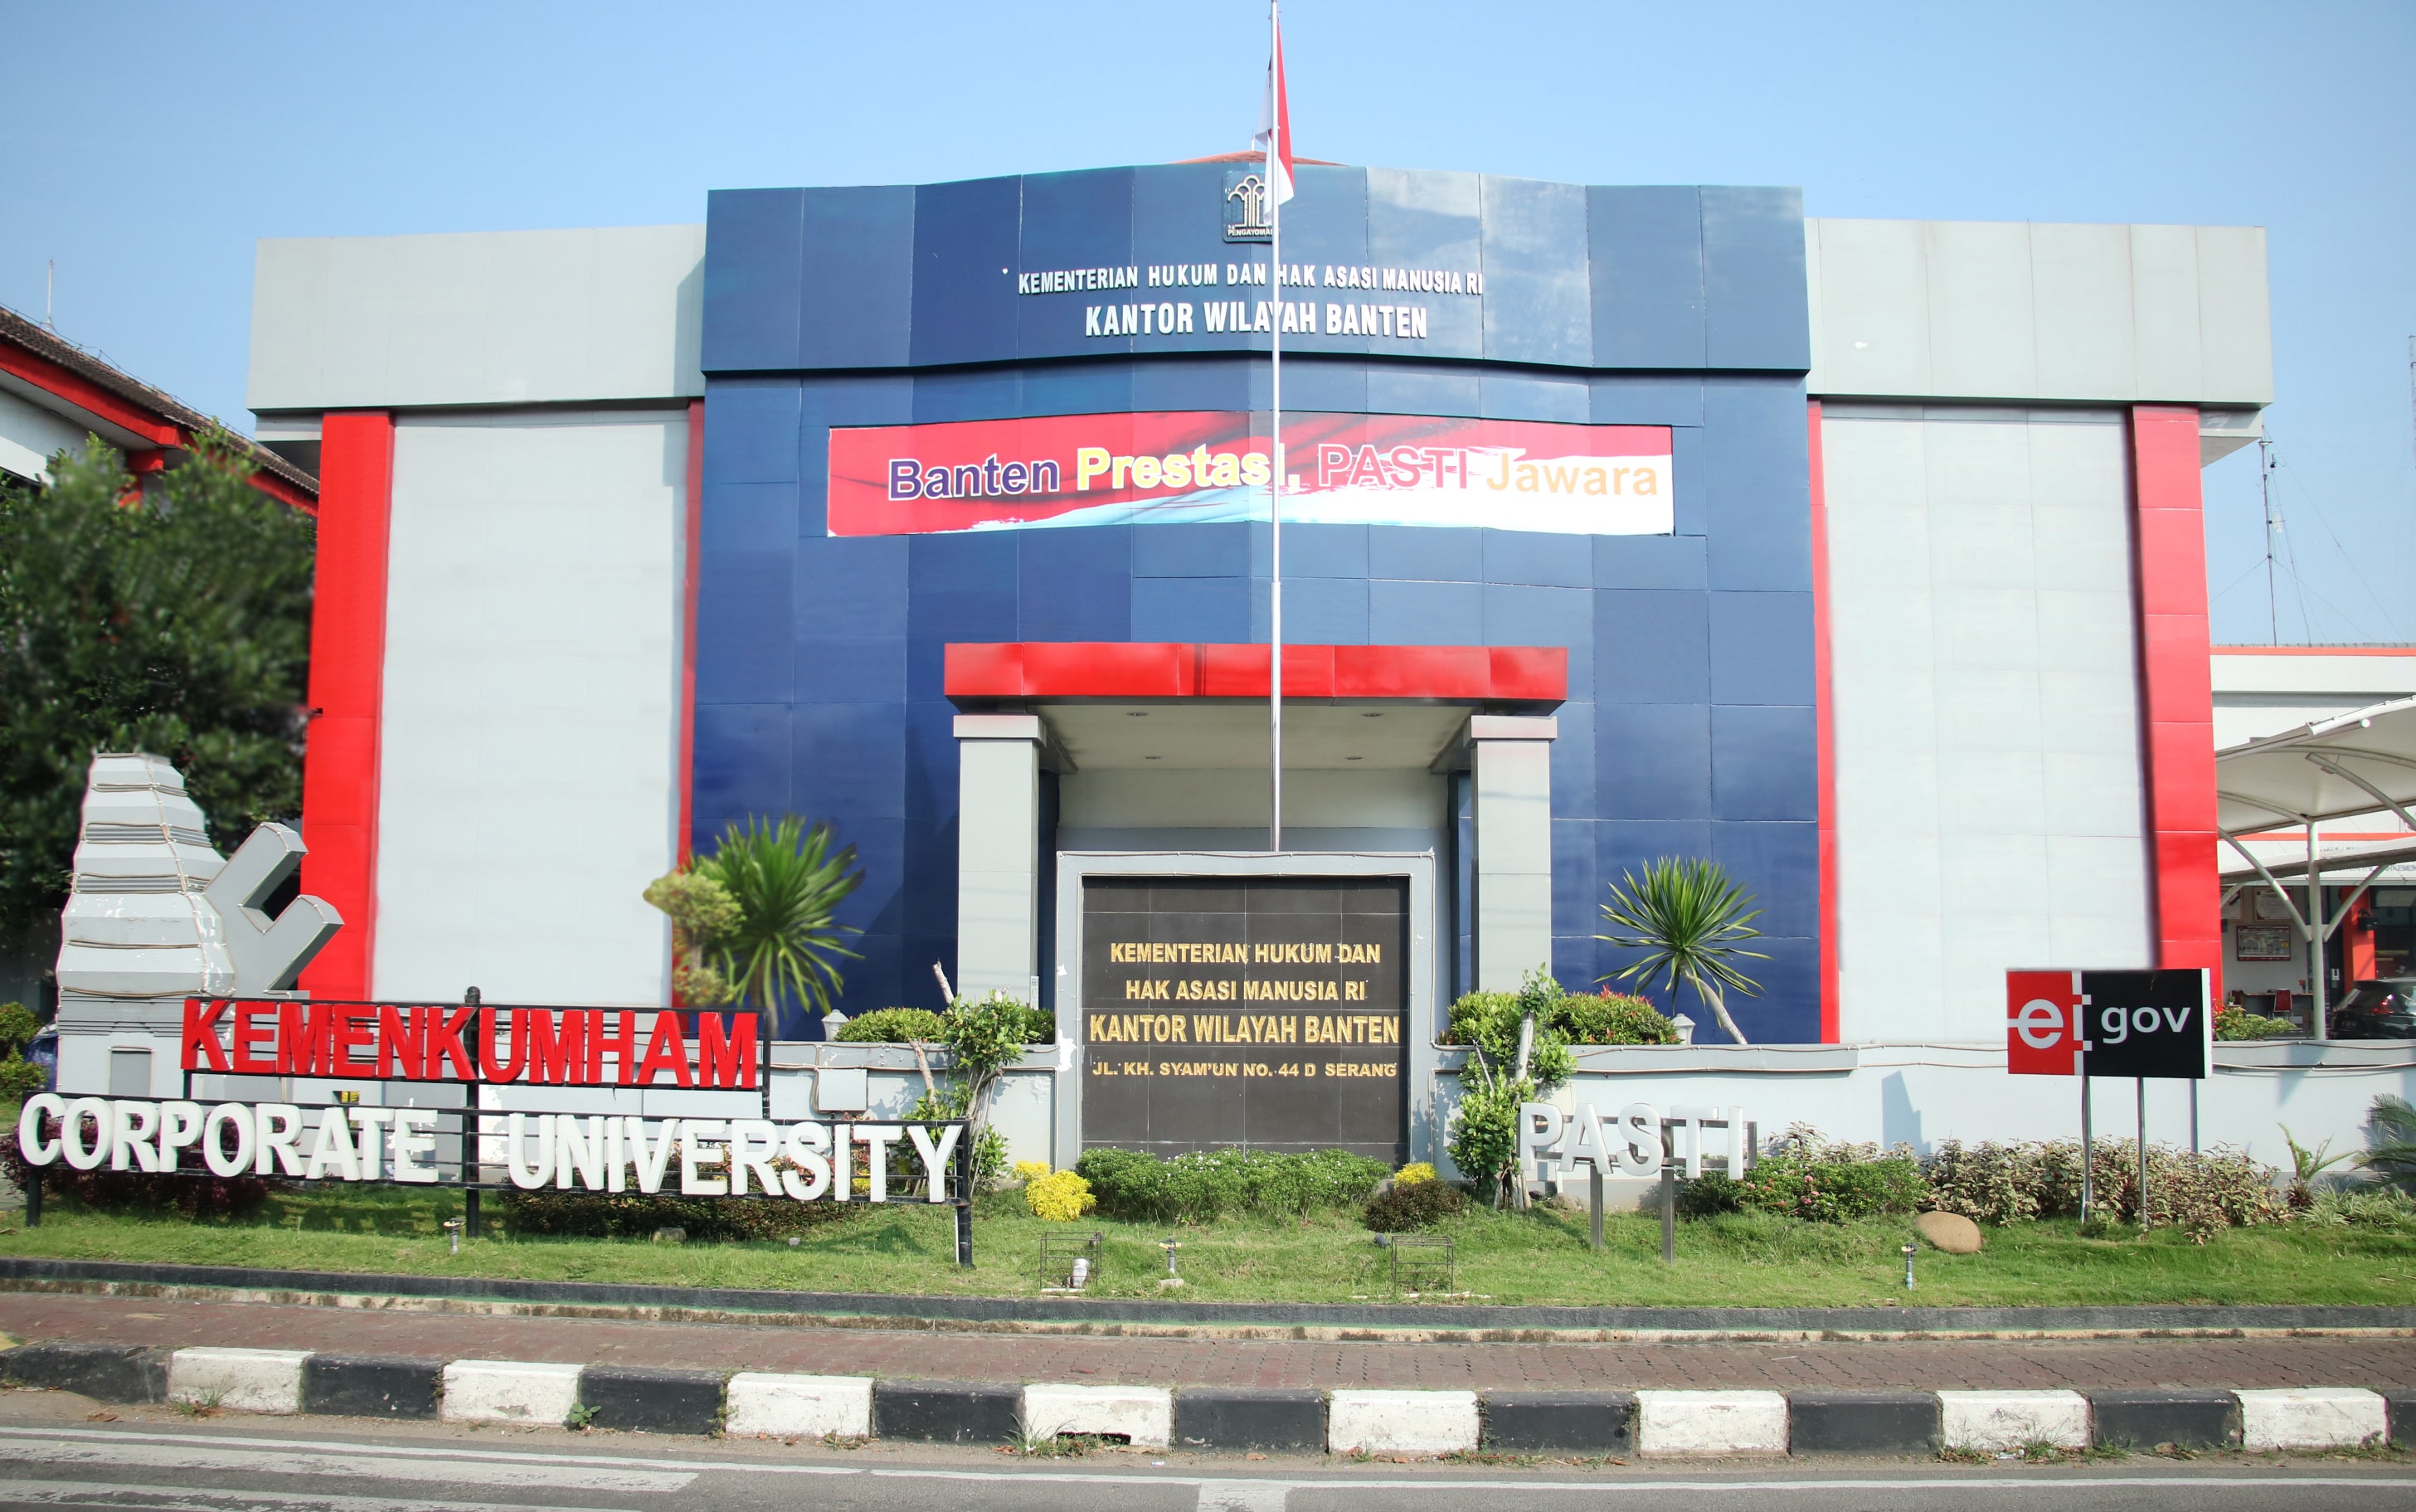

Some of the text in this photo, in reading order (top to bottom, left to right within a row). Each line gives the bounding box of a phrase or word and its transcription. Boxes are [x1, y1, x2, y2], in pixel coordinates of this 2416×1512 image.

[1018, 263, 1483, 294] KEMENTERIAN HUKUM DAN HAK ASASI MANUSIA RI
[1086, 300, 1427, 338] KANTOR WILAYAH BANTEN
[888, 454, 1060, 501] Banten
[1318, 443, 1468, 489] PASTI
[1485, 451, 1659, 496] Jawara
[1111, 943, 1381, 964] KEMENTERIAN HUKUM DAN
[1126, 980, 1365, 1001] HAK ASASI MANUSIA RI
[180, 998, 759, 1089] KEMENKUMHAM
[1090, 1014, 1400, 1043] KANTOR WILAYAH BANTEN
[1092, 1061, 1118, 1076] JL.
[1124, 1062, 1155, 1076] KH.
[1243, 1062, 1273, 1077] NO.
[1278, 1062, 1300, 1077] 44
[1305, 1062, 1316, 1077] D
[1325, 1062, 1398, 1077] SERANG
[18, 1092, 961, 1203] CORPORATE UNIVERSITY
[1519, 1102, 1744, 1180] PASTI
